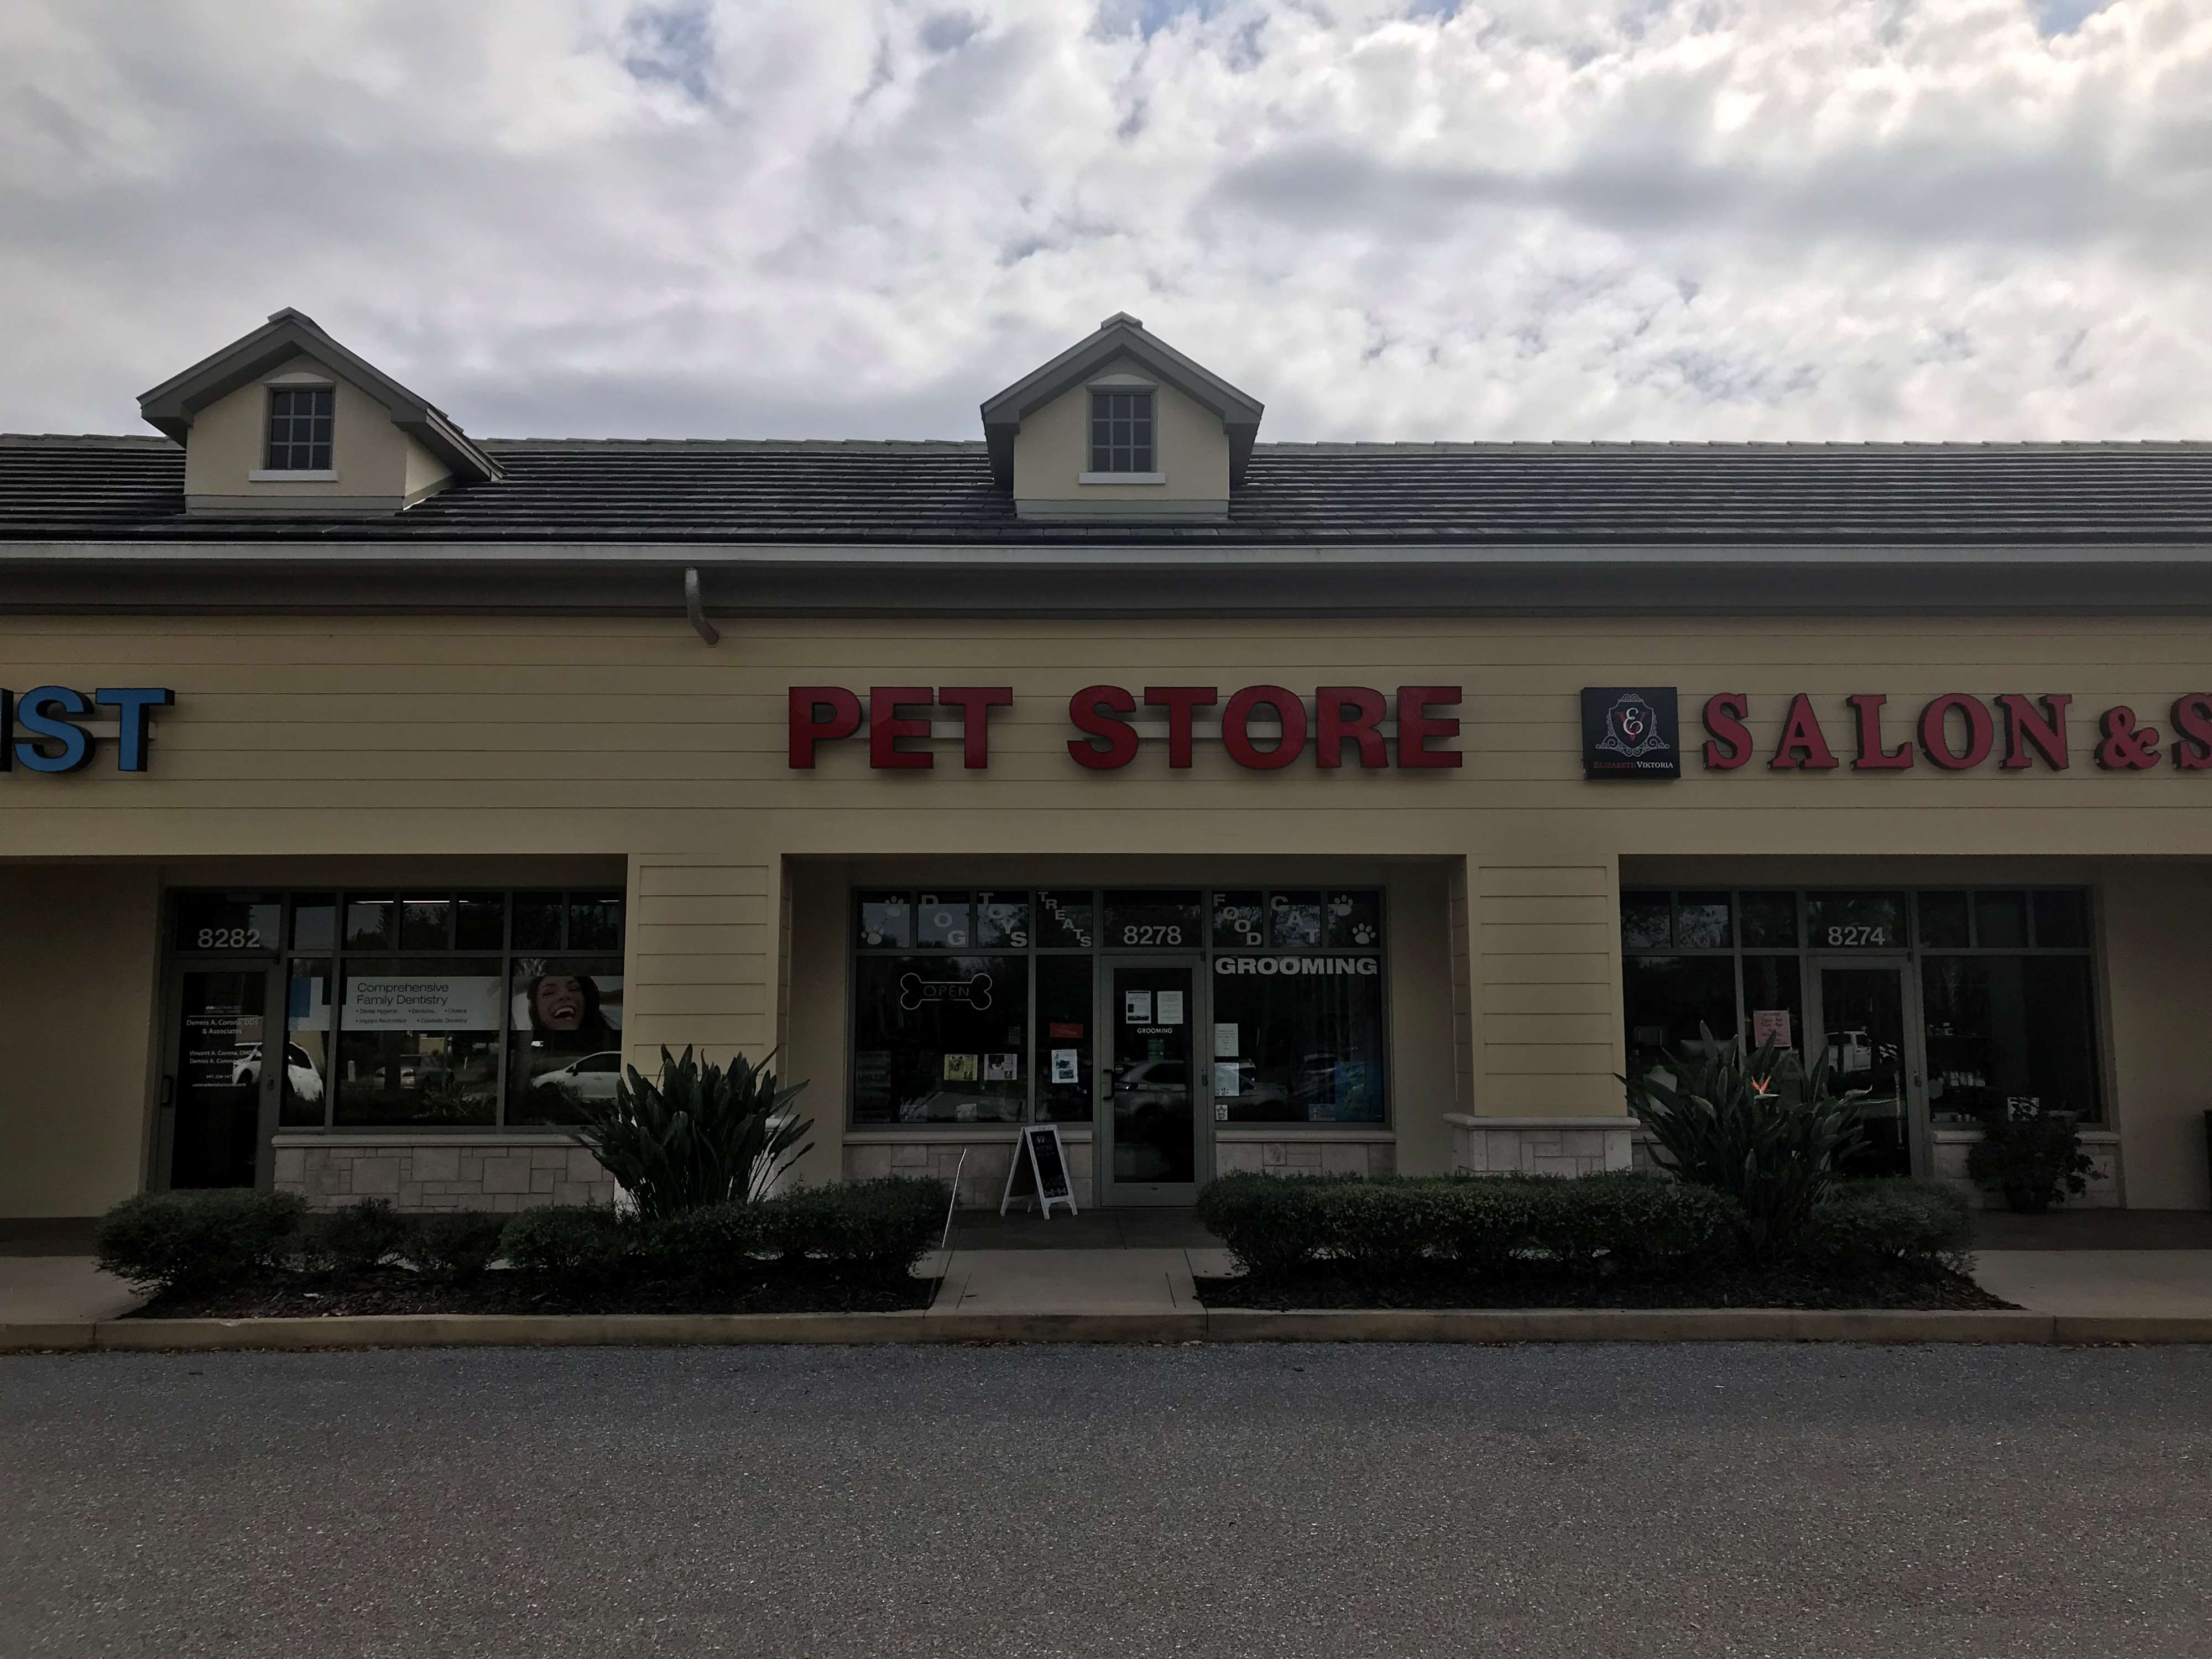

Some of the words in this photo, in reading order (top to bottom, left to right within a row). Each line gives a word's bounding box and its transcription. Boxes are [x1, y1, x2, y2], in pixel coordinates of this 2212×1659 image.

[0, 686, 174, 773] ST
[789, 687, 1013, 769] PET
[1067, 685, 1463, 769] STORE
[1702, 692, 2073, 771] SALON
[2094, 705, 2162, 771] &
[2170, 692, 2212, 771] S
[1636, 761, 1674, 769] VIKTORIA
[921, 894, 967, 946] DOG
[978, 892, 1028, 947] TOYS
[1037, 891, 1092, 947] TREATS
[1123, 925, 1182, 945] 8278
[1213, 894, 1262, 946] FOOD
[1270, 896, 1319, 944] CAT
[1827, 926, 1886, 946] 8274
[197, 928, 260, 948] 8282
[1215, 957, 1378, 975] GROOMING
[357, 982, 449, 994] Comprehensive
[357, 995, 393, 1006] Family
[397, 994, 448, 1006] Dentistry
[924, 985, 969, 998] OPEN
